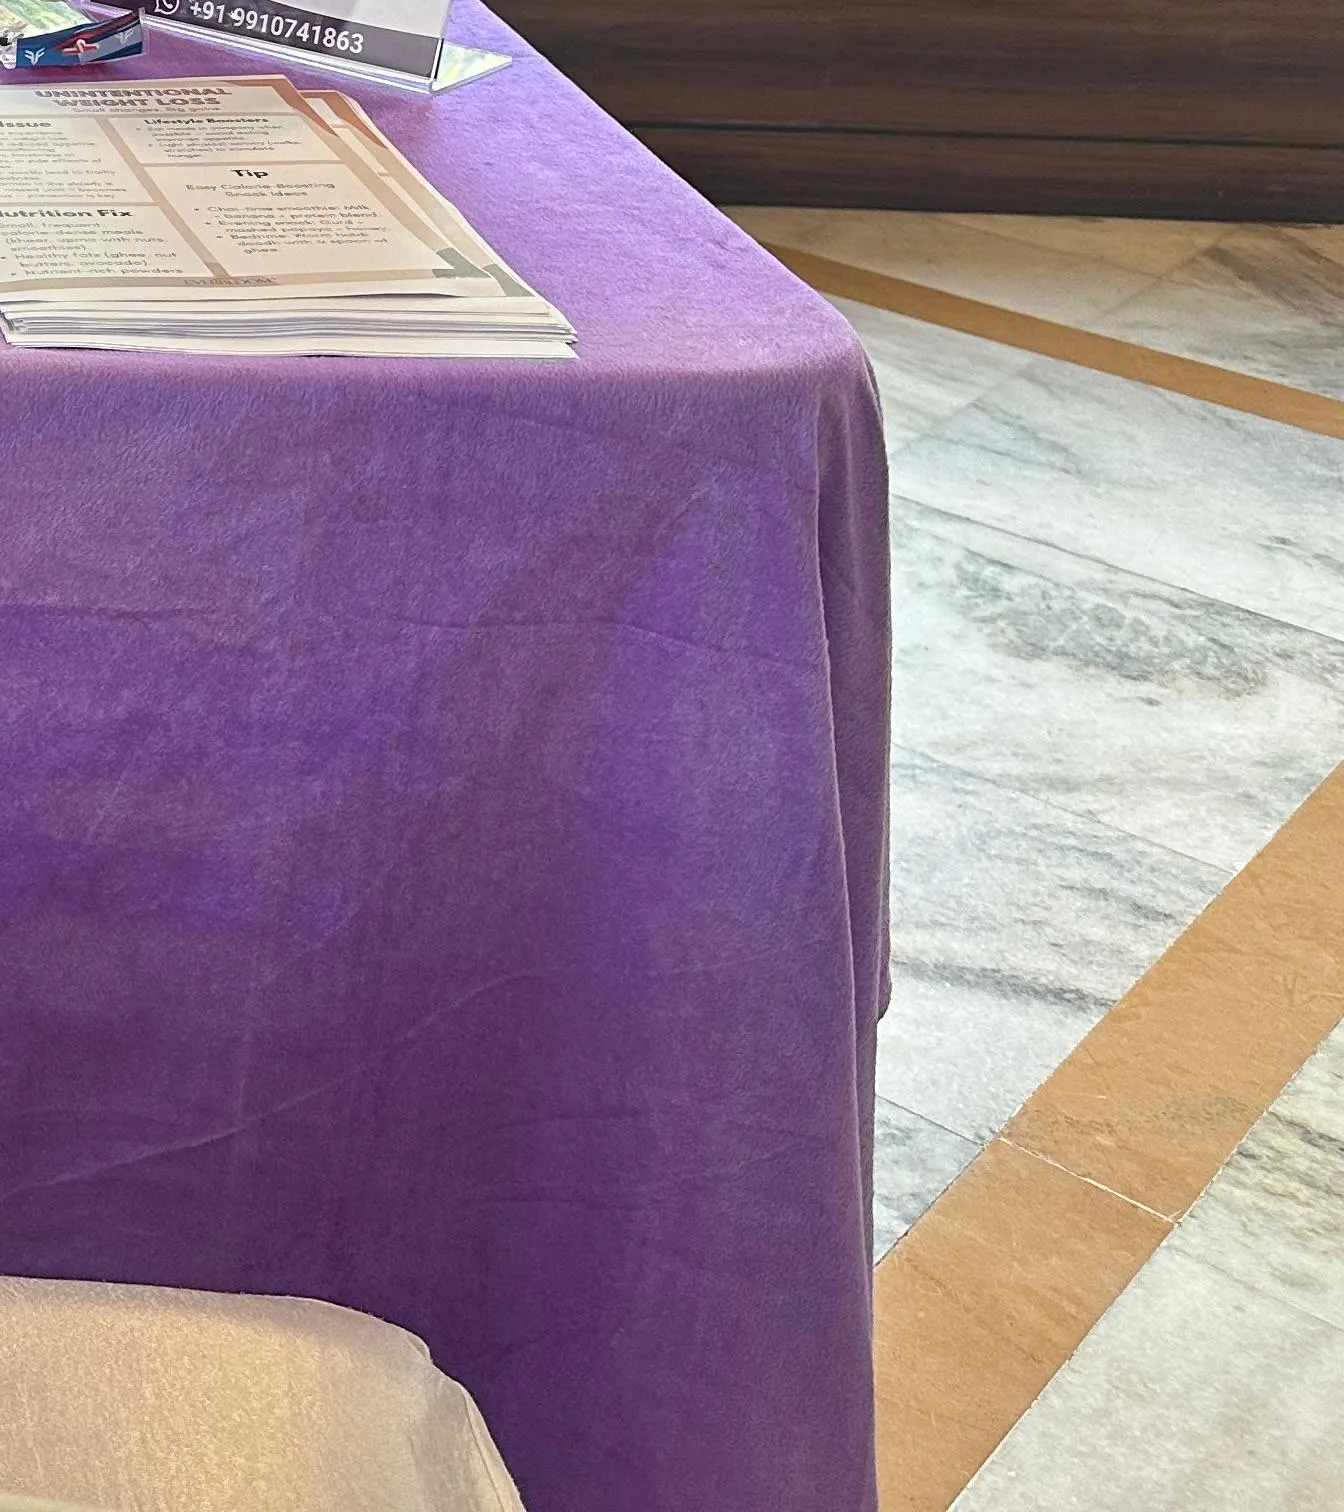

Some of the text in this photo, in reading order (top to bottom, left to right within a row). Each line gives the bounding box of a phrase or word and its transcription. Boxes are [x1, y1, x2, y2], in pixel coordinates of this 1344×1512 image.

[190, 1, 364, 54] +91 9910741863
[35, 89, 232, 98] UNINTENTIONAL
[53, 97, 221, 107] WEIGHT LOSS
[231, 169, 269, 178] Tip
[97, 209, 134, 218] Fix
